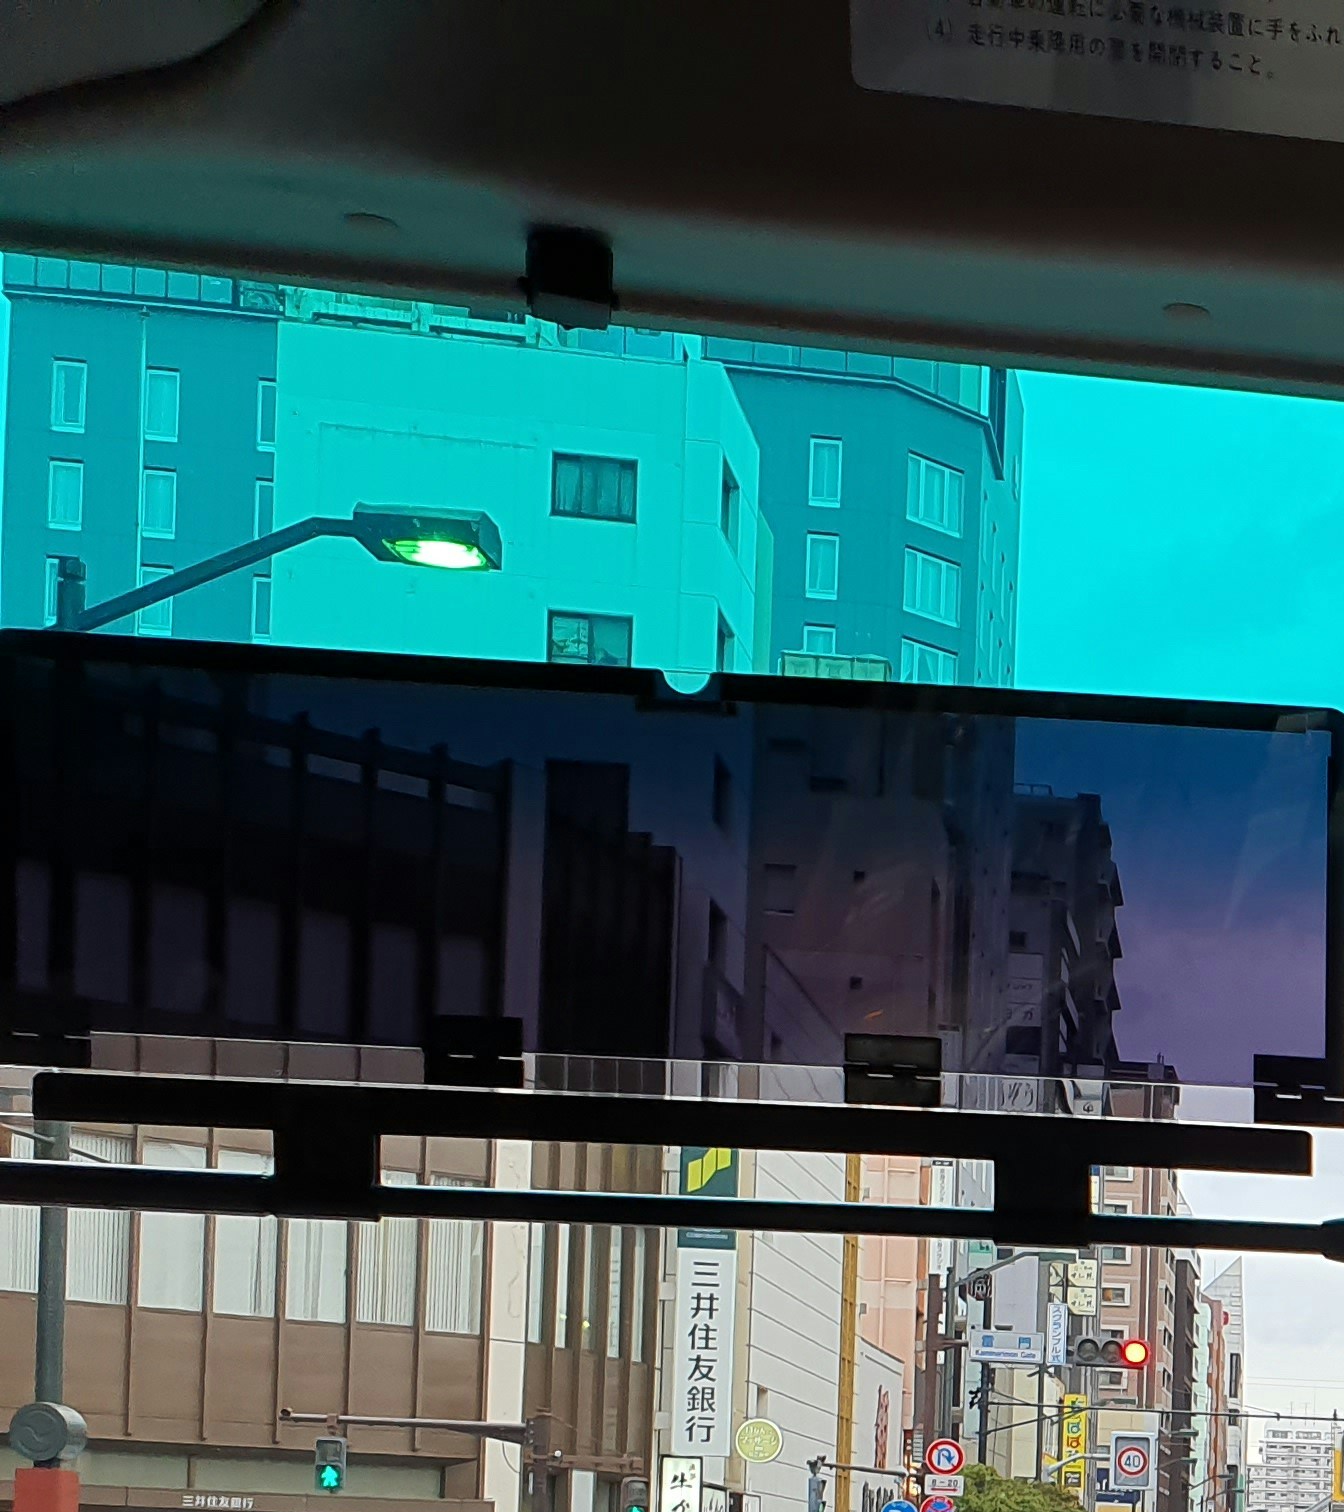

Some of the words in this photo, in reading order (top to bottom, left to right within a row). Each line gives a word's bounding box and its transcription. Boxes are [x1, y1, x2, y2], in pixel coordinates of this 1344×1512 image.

[685, 1261, 720, 1443] 三井住友銀行
[1123, 1454, 1140, 1468] 40
[182, 1495, 254, 1509] 三井住友銀行
